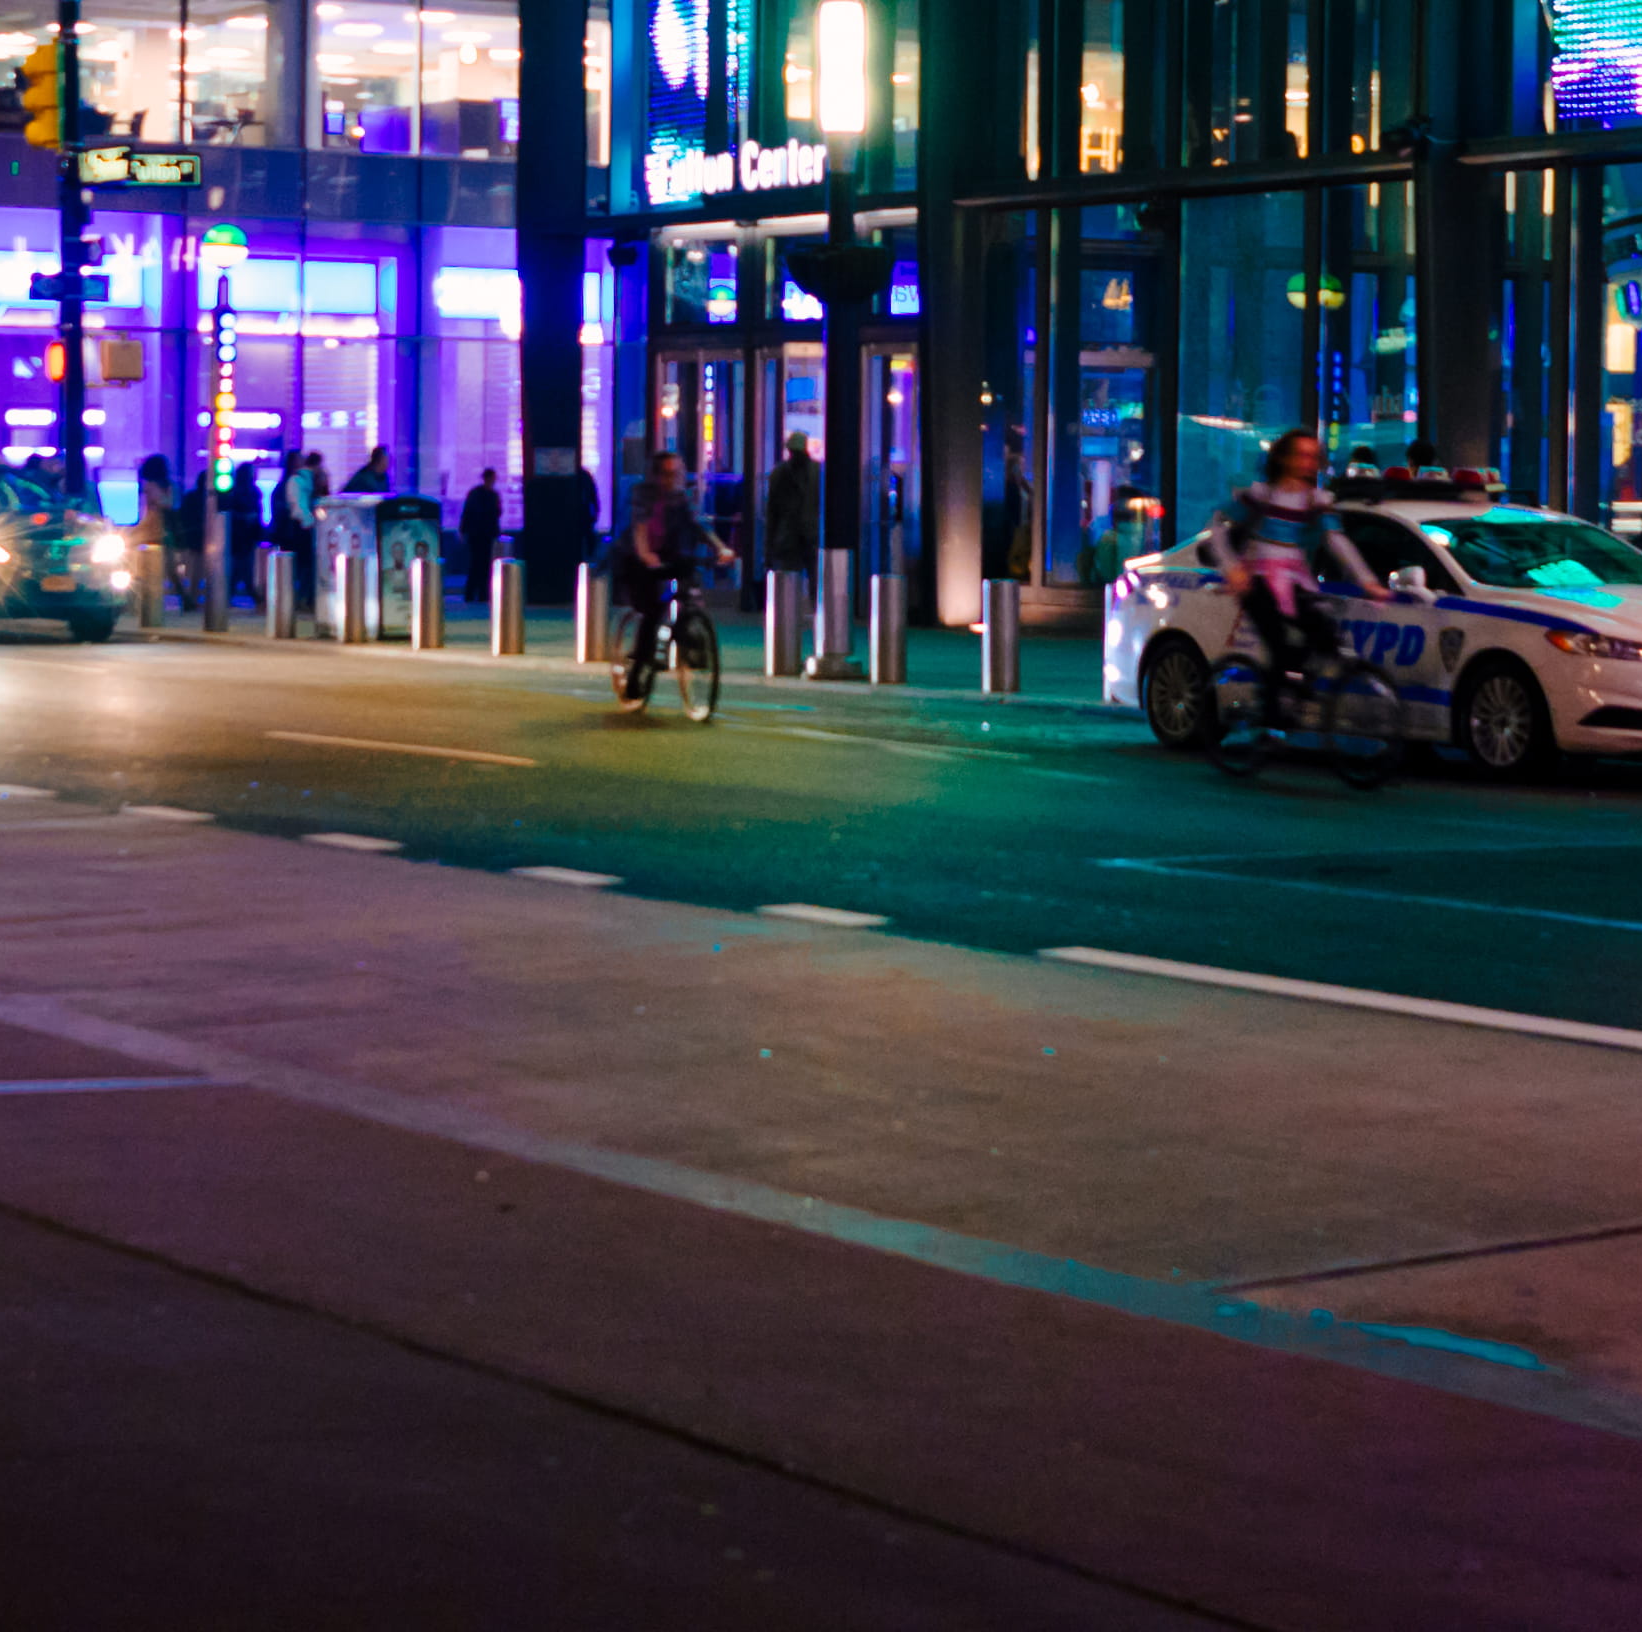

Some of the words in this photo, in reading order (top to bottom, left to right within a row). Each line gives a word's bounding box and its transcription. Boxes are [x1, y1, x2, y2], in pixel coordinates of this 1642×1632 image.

[659, 148, 734, 195] Fulton
[740, 138, 828, 192] Center
[1333, 619, 1427, 667] YPD
